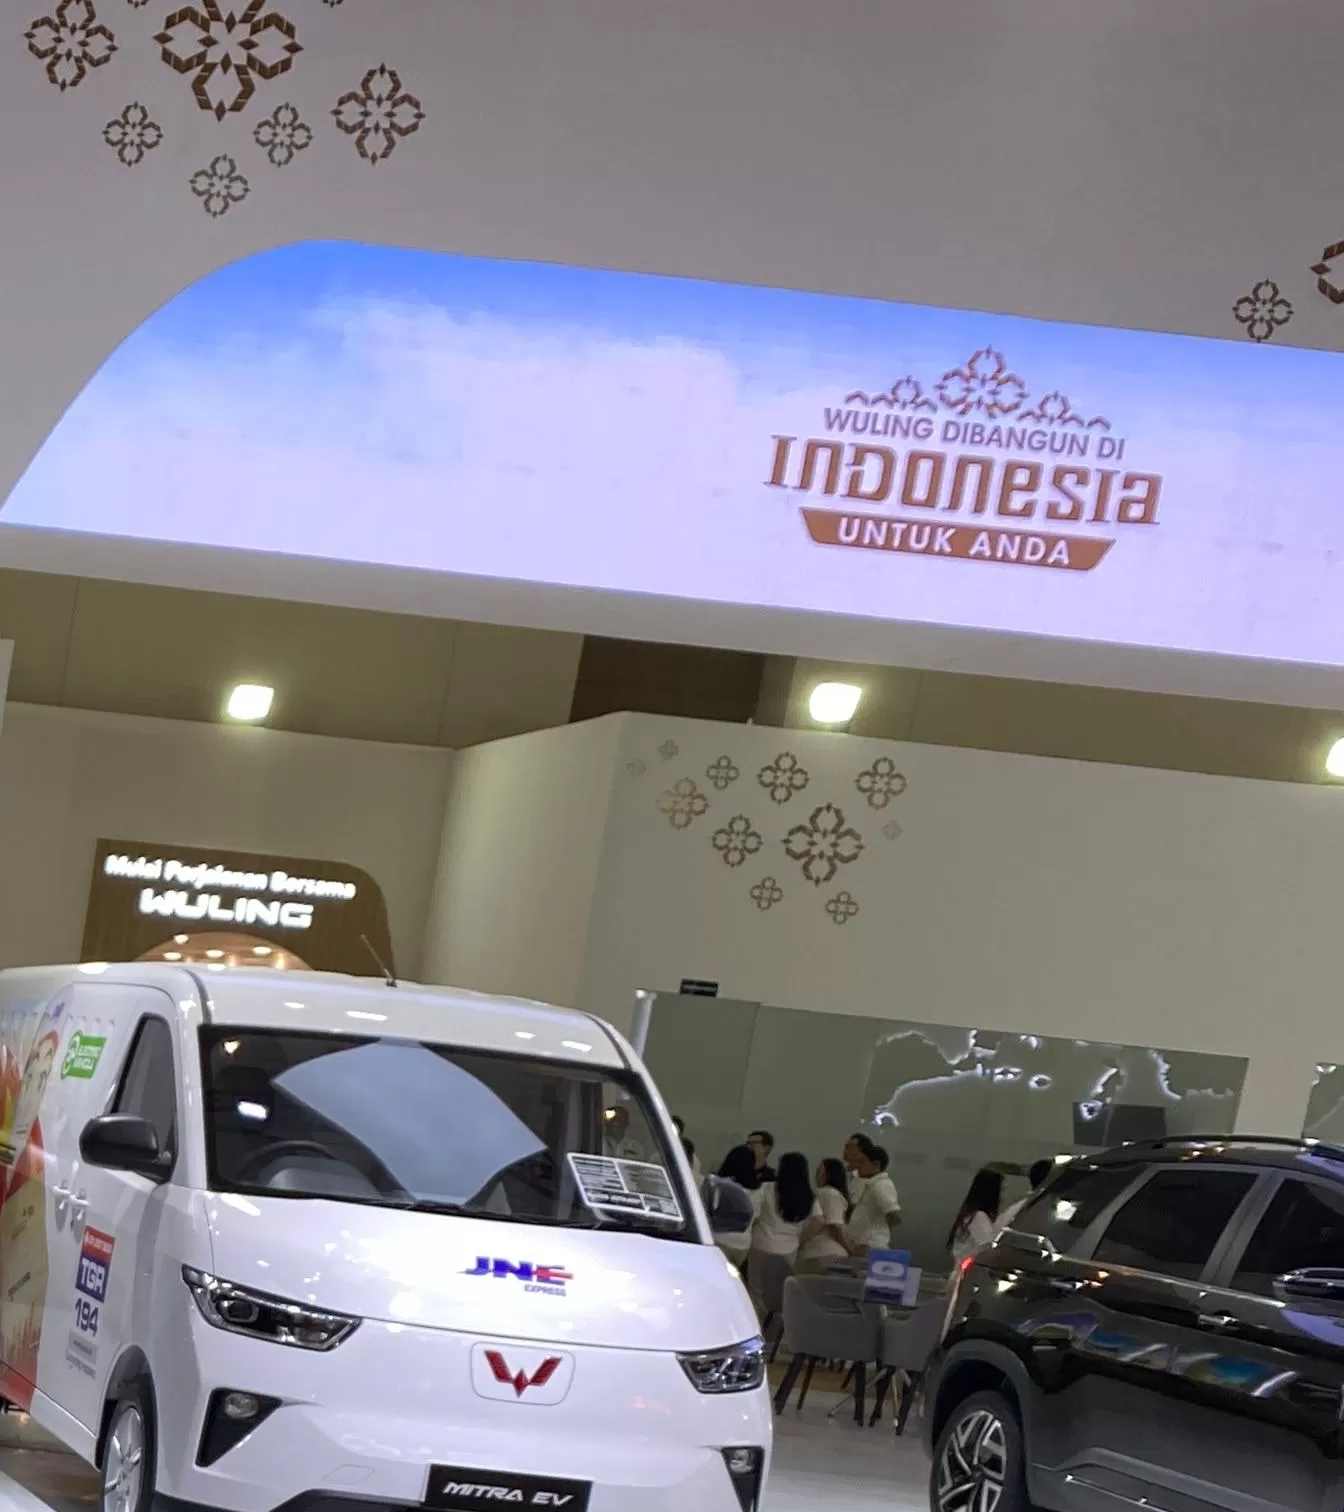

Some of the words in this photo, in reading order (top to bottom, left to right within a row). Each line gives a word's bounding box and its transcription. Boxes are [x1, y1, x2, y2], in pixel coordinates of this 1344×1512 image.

[823, 406, 934, 440] WULING
[940, 419, 1090, 458] DIBANGUN
[1097, 437, 1126, 461] DI
[837, 516, 958, 554] UNTUK
[968, 529, 1071, 567] ANDA
[138, 888, 315, 929] WULING
[462, 1256, 574, 1286] JNE
[75, 1298, 99, 1337] 194
[443, 1481, 523, 1502] MITRA
[531, 1491, 574, 1507] EV
